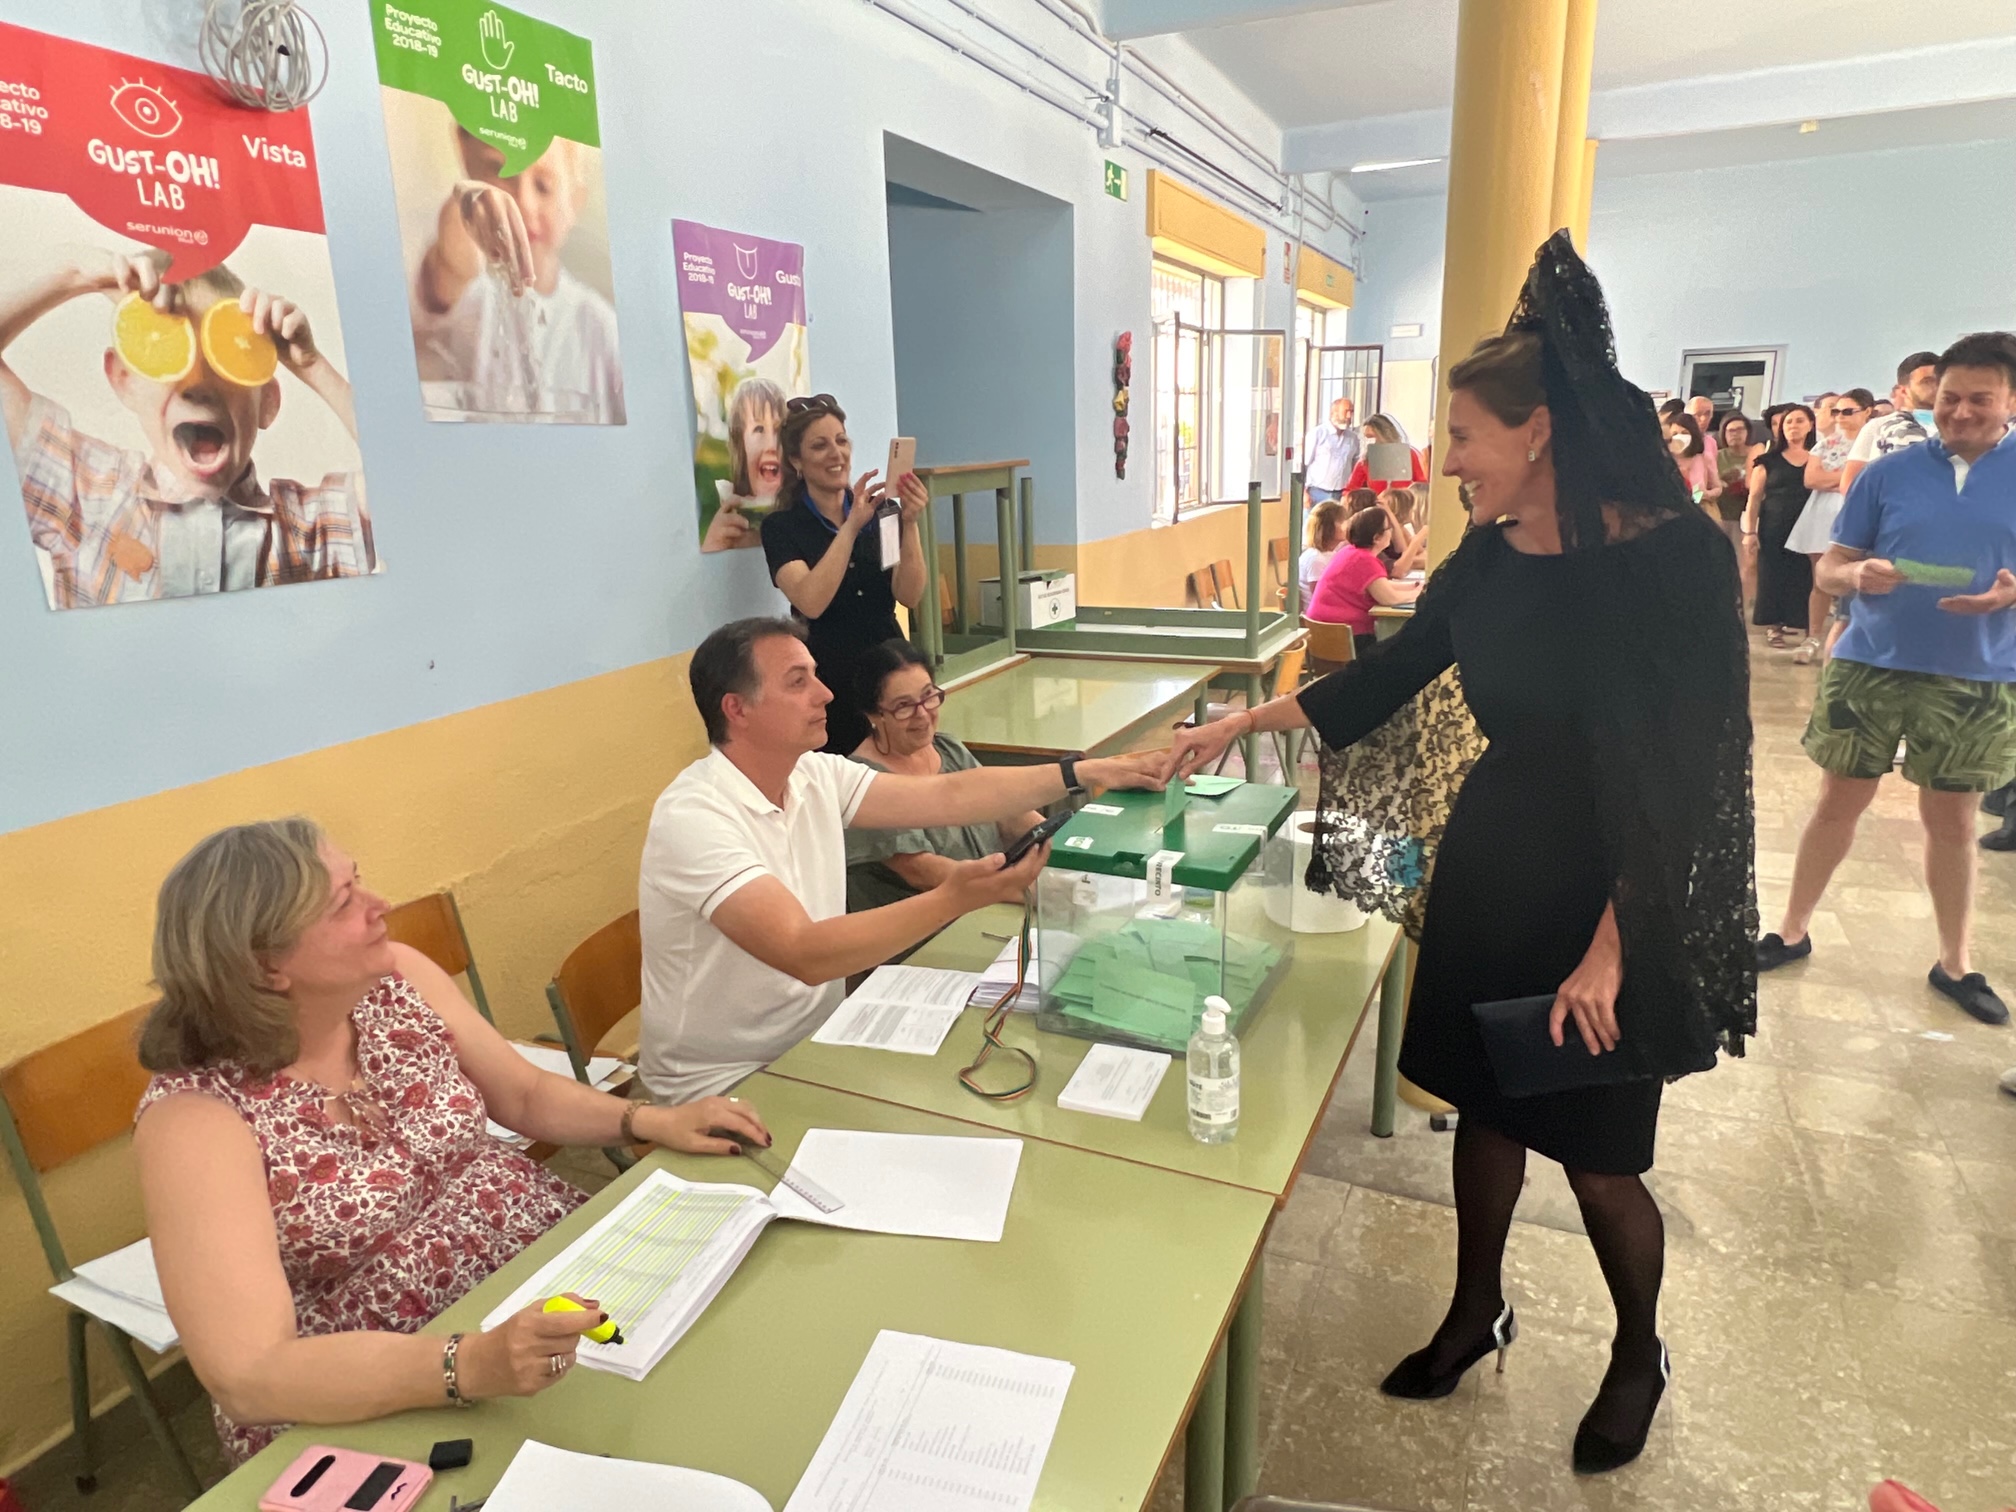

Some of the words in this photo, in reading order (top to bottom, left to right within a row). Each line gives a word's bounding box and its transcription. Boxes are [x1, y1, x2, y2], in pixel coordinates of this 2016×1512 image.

[384, 17, 442, 47] Educativo
[385, 3, 438, 32] Proyecto
[392, 33, 439, 58] 2018-19
[461, 63, 540, 109] GUST-OH!
[544, 63, 589, 94] Tacto
[489, 95, 518, 123] LAB
[87, 138, 221, 189] GUST-OH!
[242, 134, 307, 168] Vista
[136, 178, 185, 210] LAB
[126, 221, 193, 239] serunion
[727, 282, 773, 305] GUST-OH!
[744, 302, 758, 320] LAB
